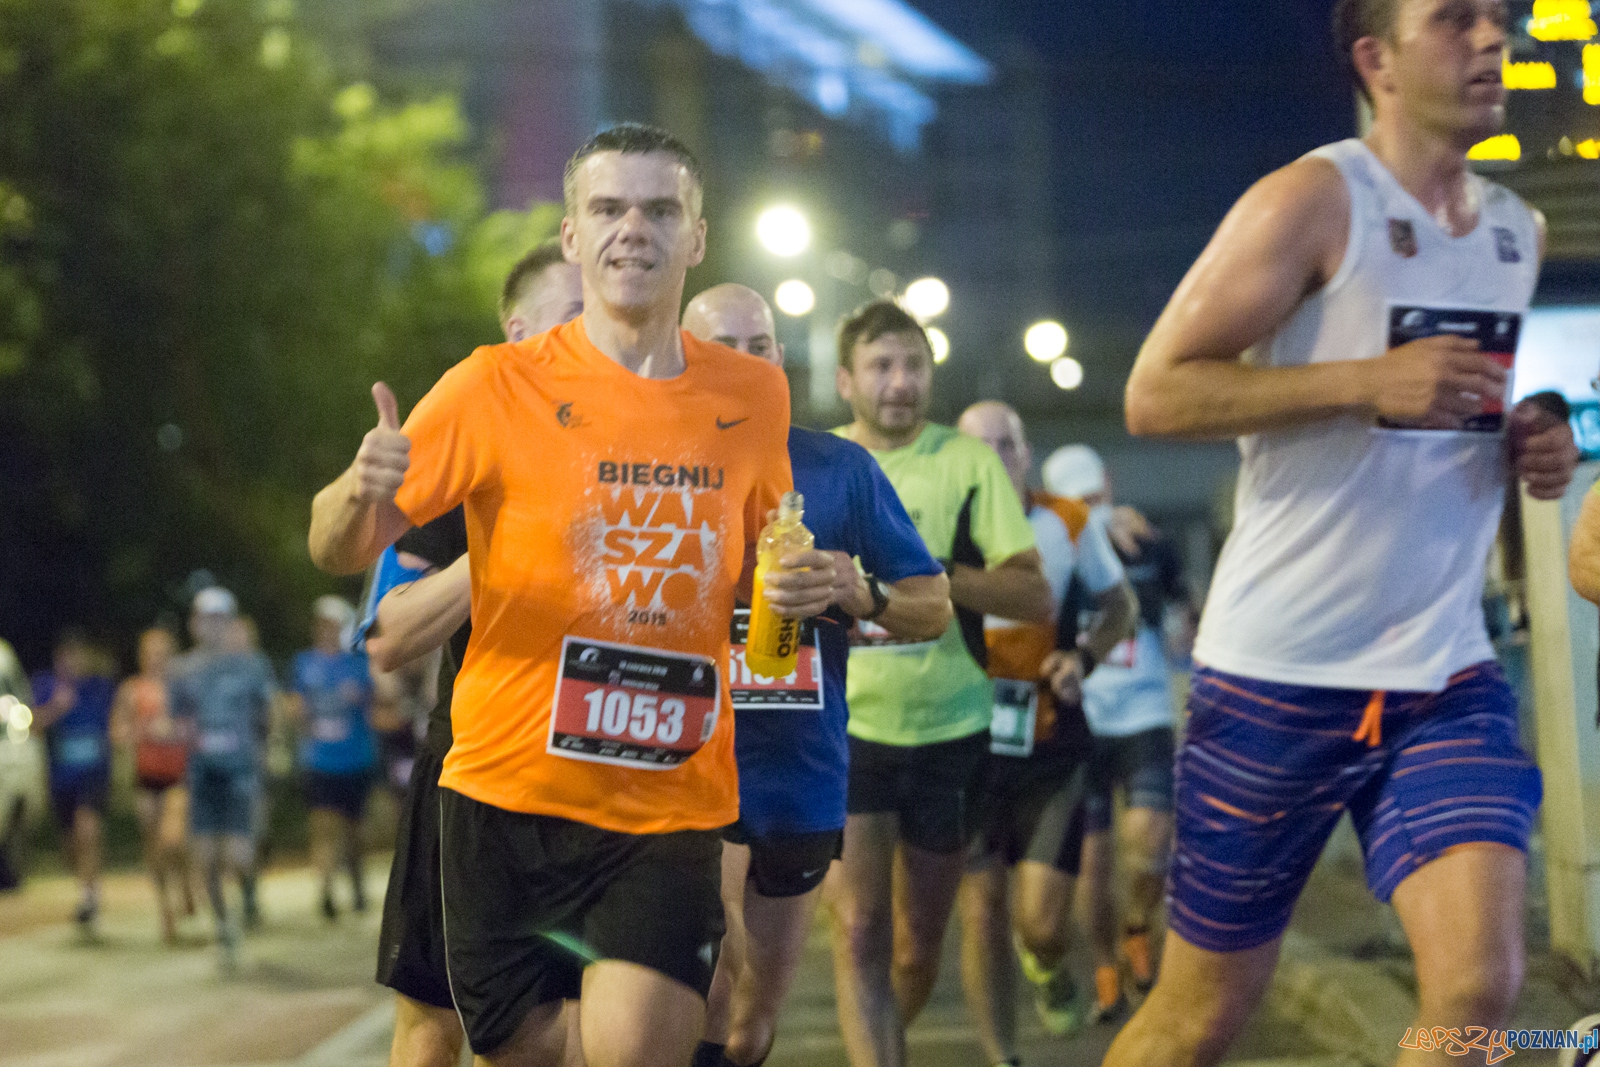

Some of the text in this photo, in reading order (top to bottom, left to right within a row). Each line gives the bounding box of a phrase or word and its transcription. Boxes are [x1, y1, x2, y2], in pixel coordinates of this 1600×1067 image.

[598, 461, 724, 490] BIEGNIJ
[602, 528, 705, 573] SZA
[605, 568, 699, 611] WO
[583, 688, 686, 744] 1053
